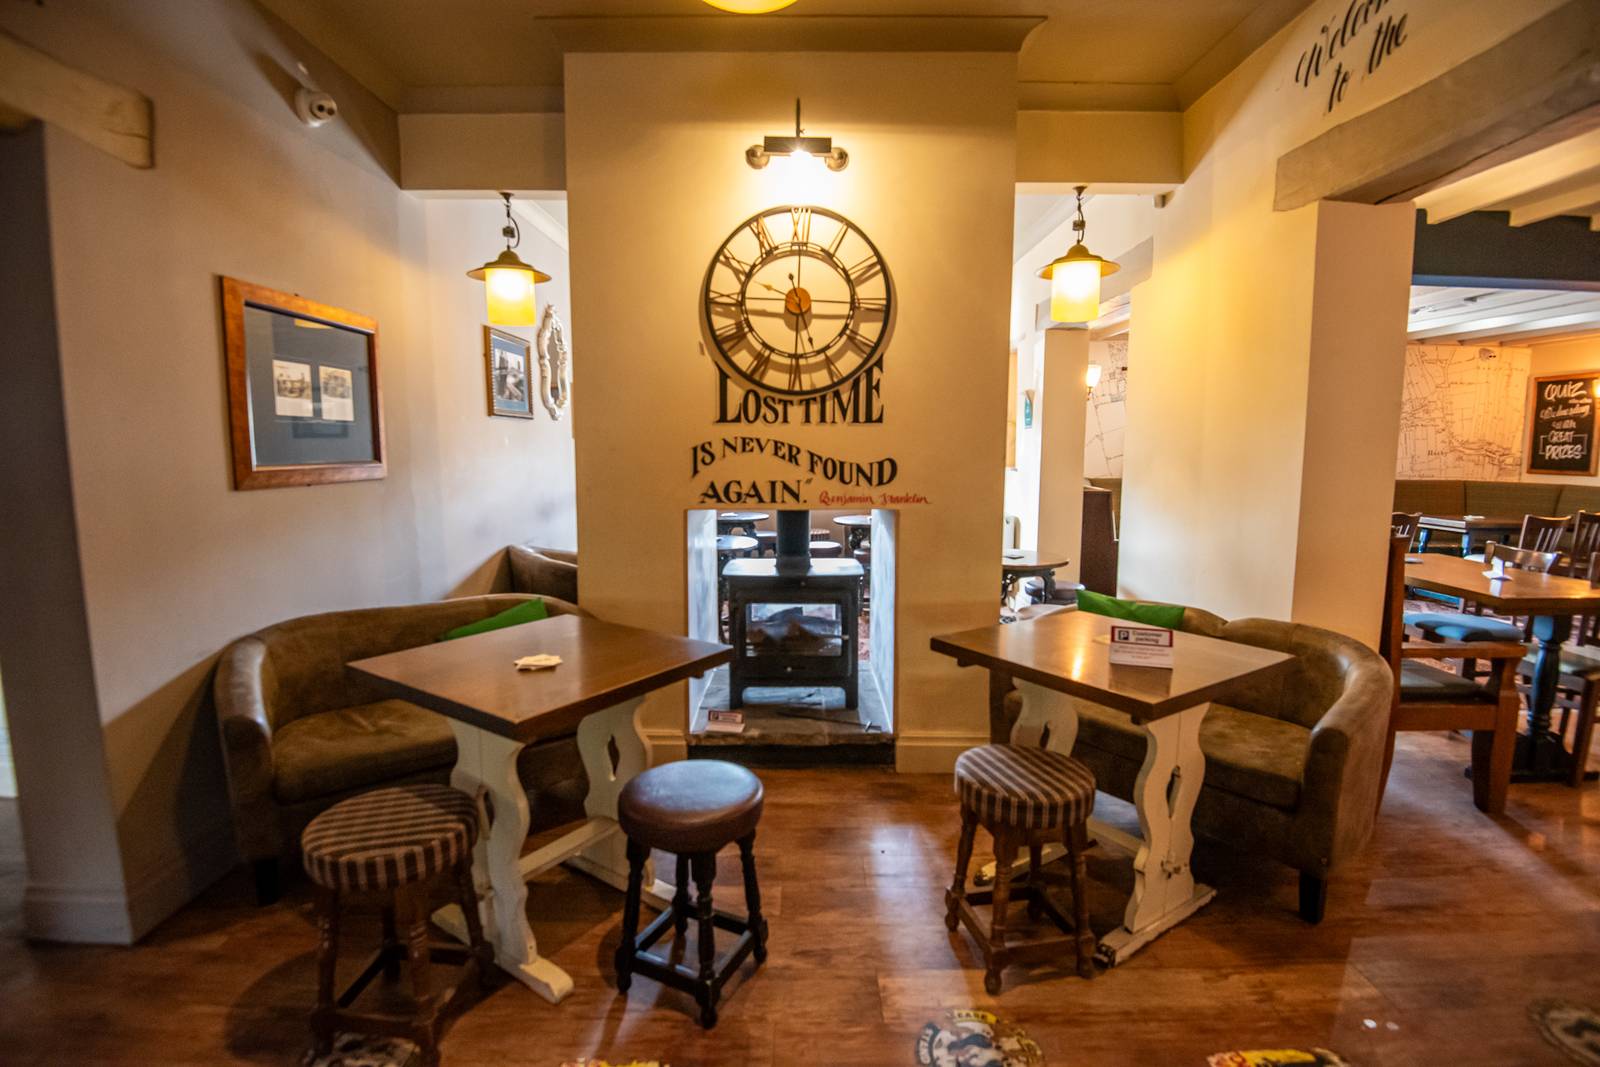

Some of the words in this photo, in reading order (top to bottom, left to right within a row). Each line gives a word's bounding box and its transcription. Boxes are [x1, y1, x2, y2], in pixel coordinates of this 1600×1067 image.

[1326, 62, 1351, 113] to
[1366, 13, 1409, 75] the
[714, 361, 794, 424] LOST
[801, 352, 884, 424] TIME
[1545, 444, 1583, 460] PRIZES
[1548, 430, 1576, 443] GREAT
[692, 441, 716, 478] IS
[721, 436, 801, 466] NEVER
[806, 450, 898, 487] FOUND
[819, 490, 875, 506] Benjamin
[879, 491, 932, 505] Franklin
